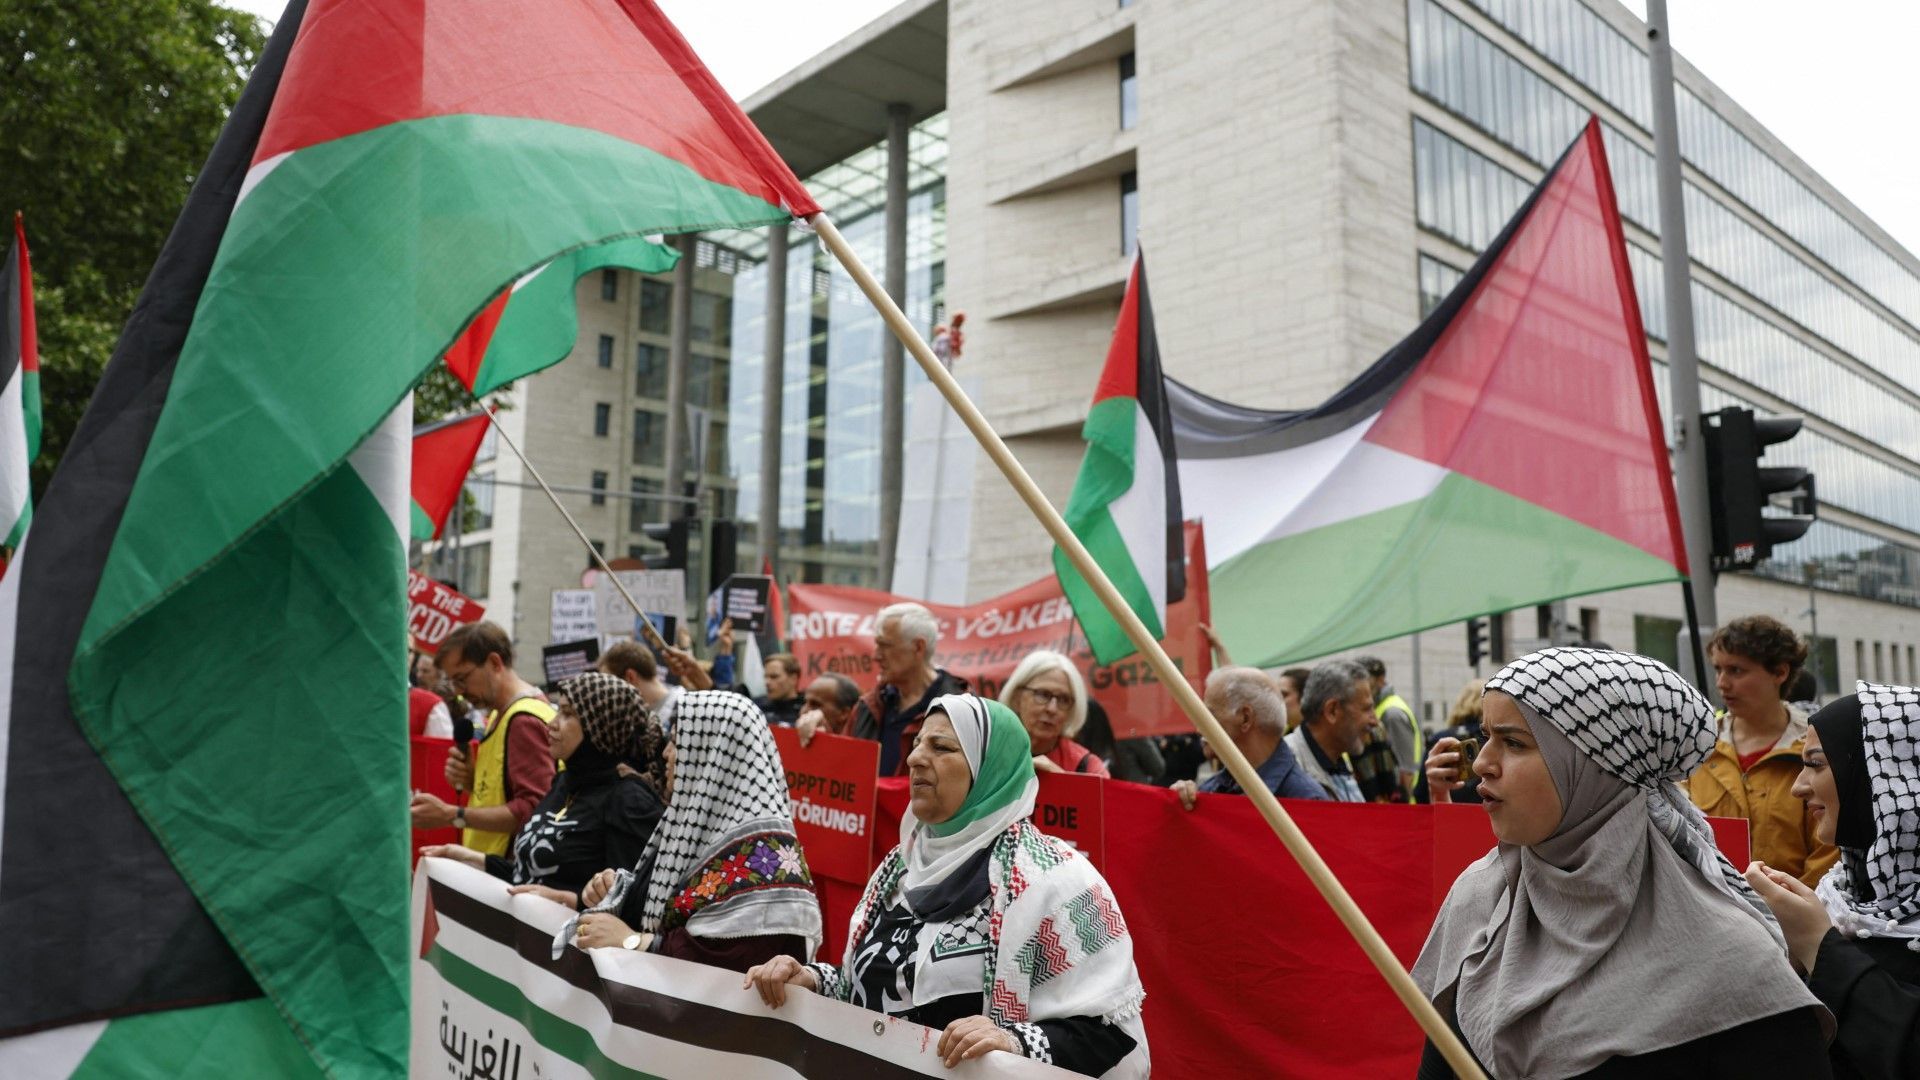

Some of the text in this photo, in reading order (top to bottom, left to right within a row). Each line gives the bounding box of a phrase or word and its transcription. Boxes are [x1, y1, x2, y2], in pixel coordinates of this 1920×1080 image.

[432, 586, 466, 616] THE
[790, 610, 859, 640] ROTE
[807, 649, 873, 675] Keine
[1088, 658, 1184, 690] Gaz
[786, 771, 856, 803] OPPT DIE
[789, 796, 866, 837] TÖRUNG!
[1043, 804, 1077, 830] DIE
